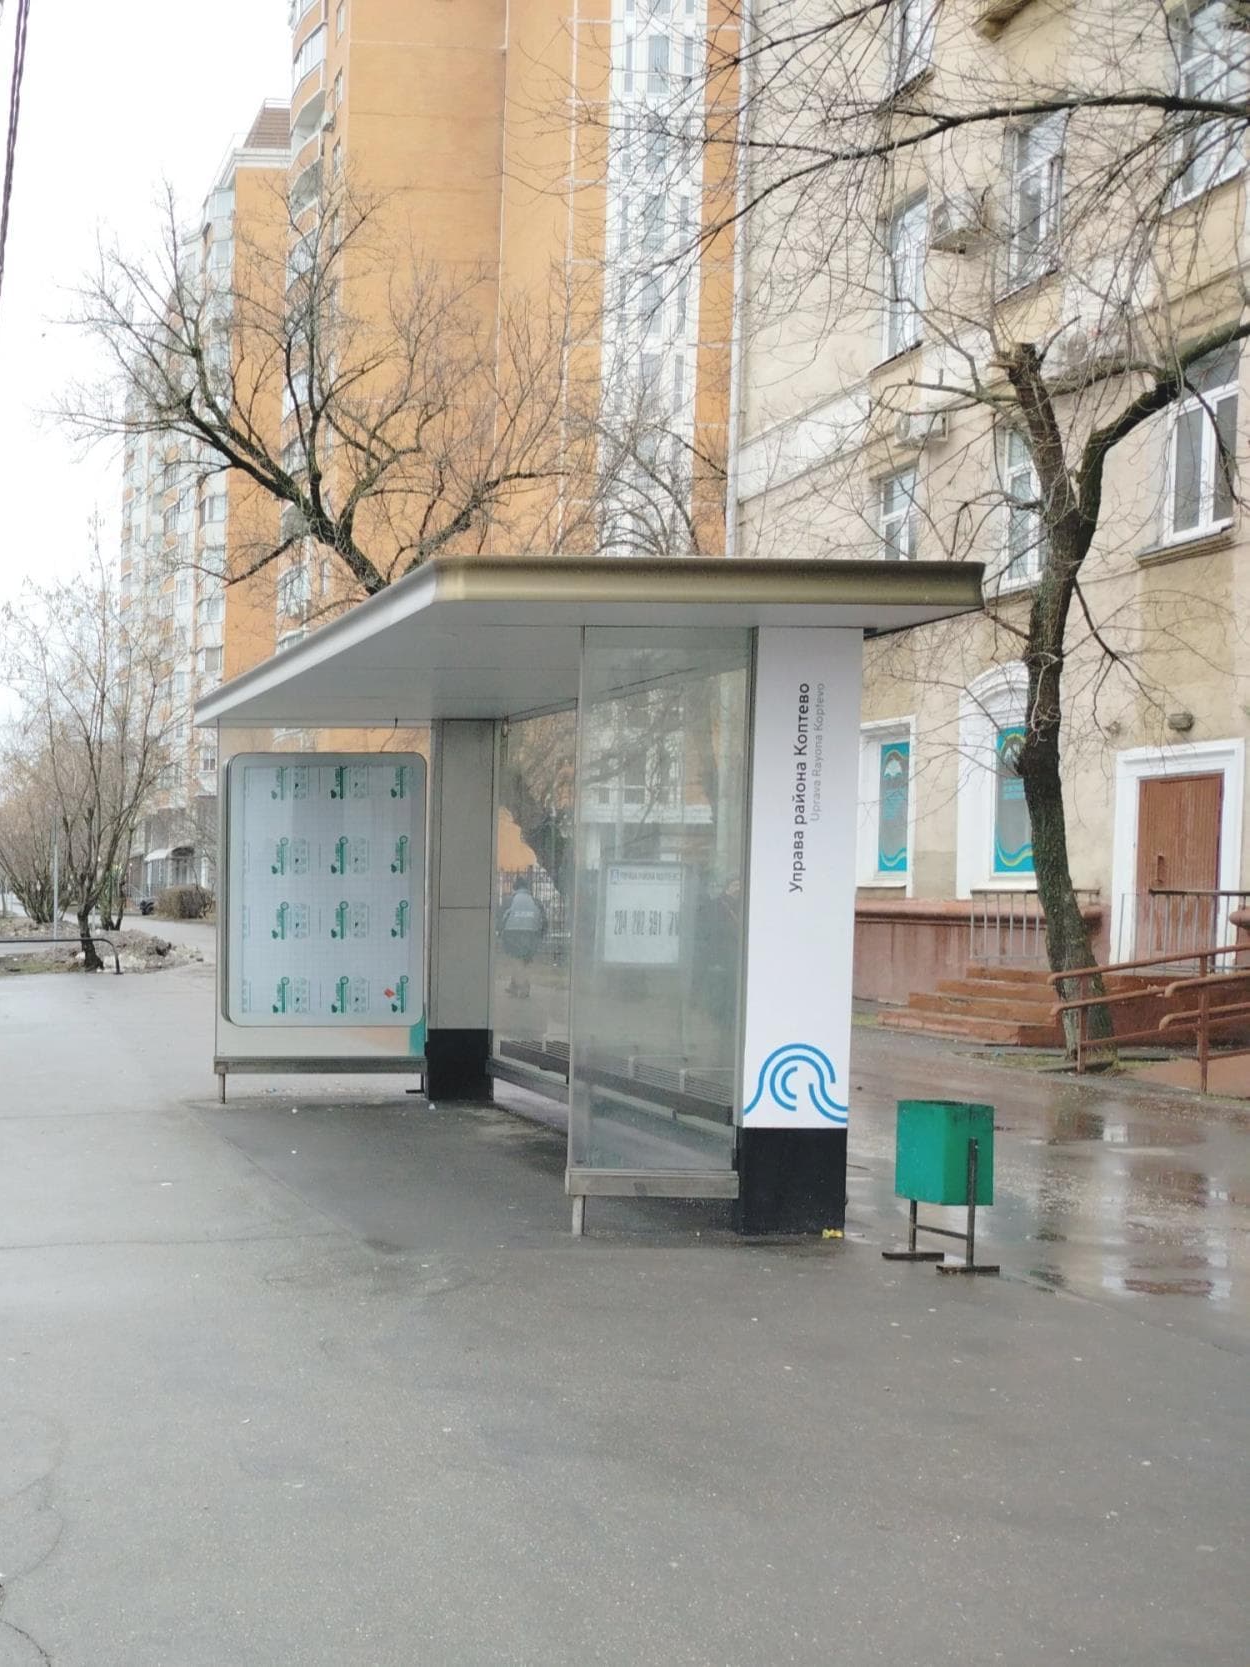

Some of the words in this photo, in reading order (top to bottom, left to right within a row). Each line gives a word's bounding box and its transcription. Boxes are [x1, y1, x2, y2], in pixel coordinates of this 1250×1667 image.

[793, 683, 810, 756] Коптево
[814, 683, 825, 731] Koptevo
[811, 735, 823, 777] Rayona
[792, 762, 807, 825] района
[810, 779, 822, 821] Uprava
[789, 831, 806, 892] Управа
